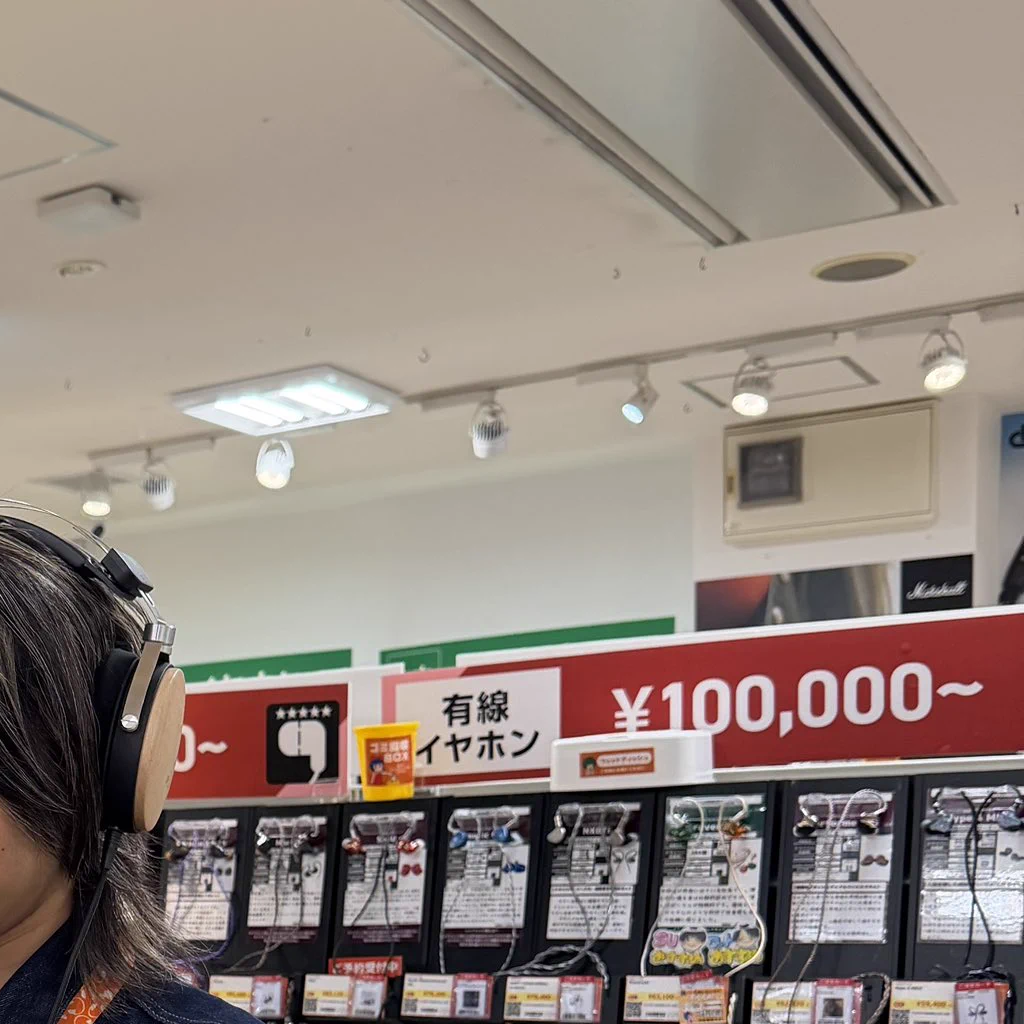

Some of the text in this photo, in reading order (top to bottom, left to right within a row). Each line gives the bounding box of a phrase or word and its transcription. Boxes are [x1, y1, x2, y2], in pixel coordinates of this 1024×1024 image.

[442, 690, 509, 727] 有線
[415, 730, 539, 765] イヤホン
